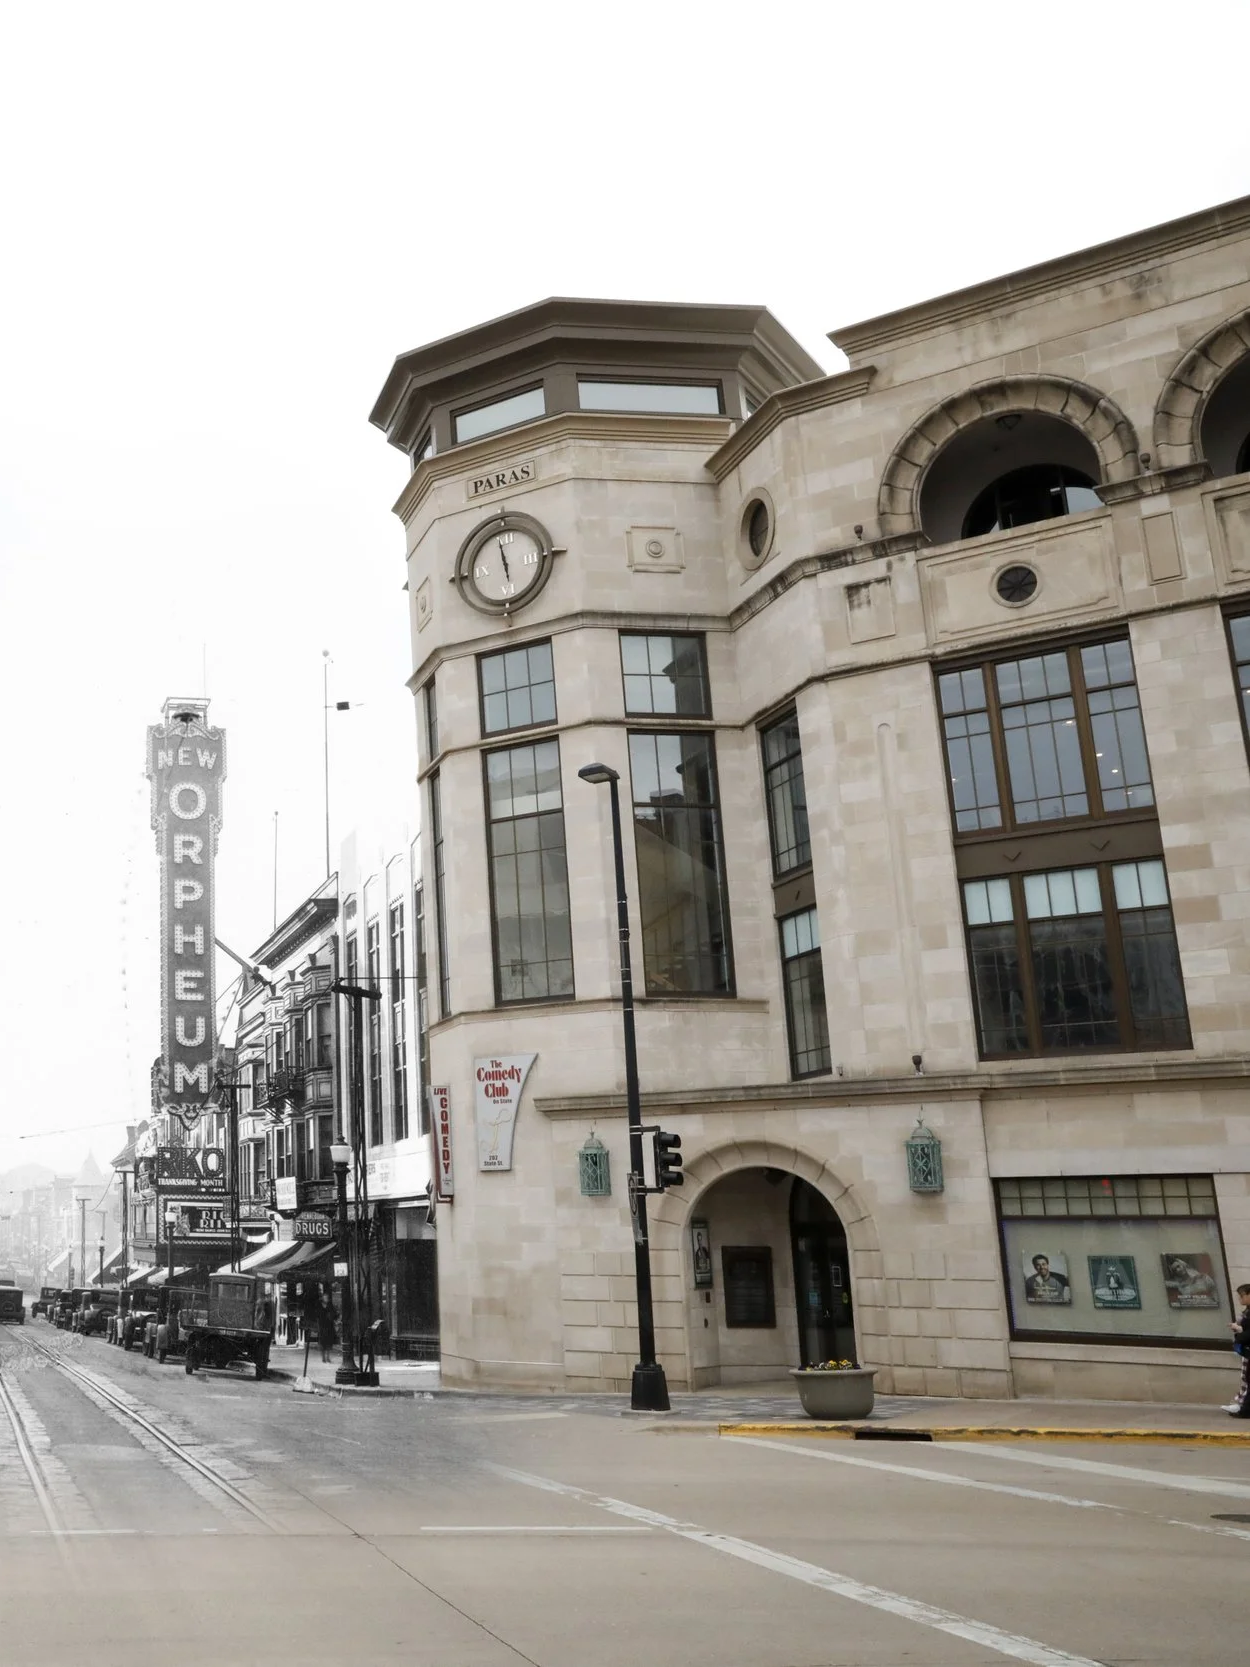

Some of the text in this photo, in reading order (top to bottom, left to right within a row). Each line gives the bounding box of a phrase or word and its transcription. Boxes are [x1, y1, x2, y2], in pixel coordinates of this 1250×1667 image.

[473, 465, 530, 494] PARAS
[523, 551, 539, 565] III
[475, 566, 490, 578] IX
[501, 583, 516, 596] VI
[157, 746, 218, 771] NEW
[169, 781, 209, 1094] ORPHEUM
[490, 1060, 503, 1069] The
[477, 1065, 522, 1083] Comedy
[434, 1087, 448, 1096] LIVE
[484, 1082, 509, 1098] Club
[440, 1097, 450, 1174] COMEDY
[158, 1148, 225, 1178] RKO
[200, 1179, 224, 1187] MONTH
[295, 1222, 329, 1235] DRUGS
